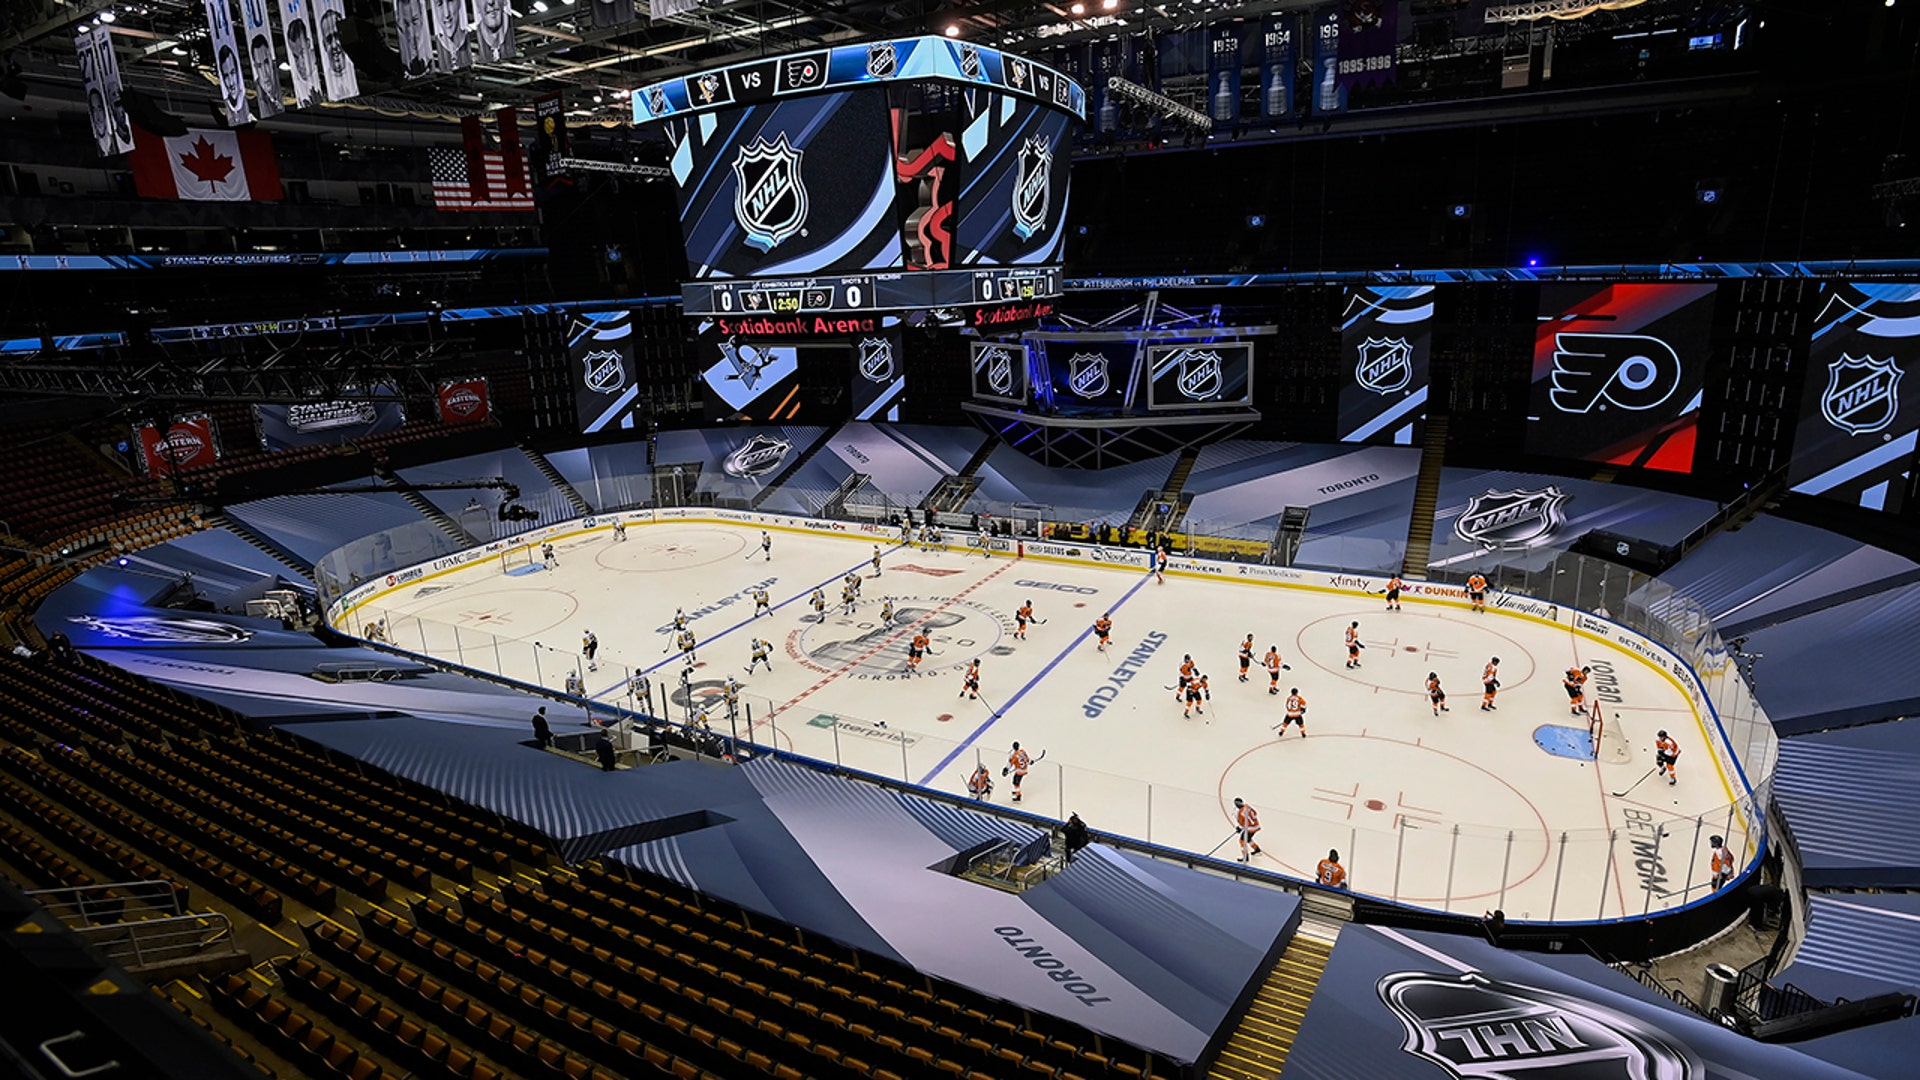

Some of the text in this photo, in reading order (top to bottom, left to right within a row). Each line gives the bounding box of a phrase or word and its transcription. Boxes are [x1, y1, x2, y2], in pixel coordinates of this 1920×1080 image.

[1265, 30, 1291, 47] 1964
[741, 72, 762, 89] VS
[1038, 75, 1050, 91] VS
[751, 167, 787, 218] NHL
[1022, 168, 1047, 208] NHL
[165, 255, 291, 265] STANLEY CUP QUALIFIERS
[983, 279, 992, 300] 0
[1084, 279, 1134, 288] PITTSBURGH
[1142, 278, 1196, 287] PHILADELPHIA
[721, 291, 732, 311] 0
[773, 297, 799, 310] 12:50
[847, 285, 861, 307] 0
[719, 317, 874, 335] Scotiabank Arena
[593, 359, 616, 385] NHL
[867, 351, 886, 372] NHL
[1368, 355, 1402, 381] NHL
[1077, 364, 1100, 387] NHL
[1187, 363, 1212, 388] NHL
[1838, 375, 1887, 415] NHL
[290, 407, 358, 425] QUALIFIERS
[743, 446, 781, 468] NHL
[1318, 473, 1380, 496] TORONTO
[1470, 502, 1539, 532] NHL
[433, 553, 466, 571] UPMC
[1168, 562, 1222, 573] BETRIVERS
[1014, 578, 1099, 595] GEICO
[1329, 575, 1371, 591] xfinity
[1495, 594, 1549, 618] Yuengling
[1082, 631, 1168, 719] STANLEY CUP
[1590, 659, 1624, 703] roman
[1622, 808, 1671, 895] BETMGM
[1324, 870, 1333, 883] 9
[993, 926, 1112, 1008] TORONTO
[1436, 1014, 1590, 1059] NHL
